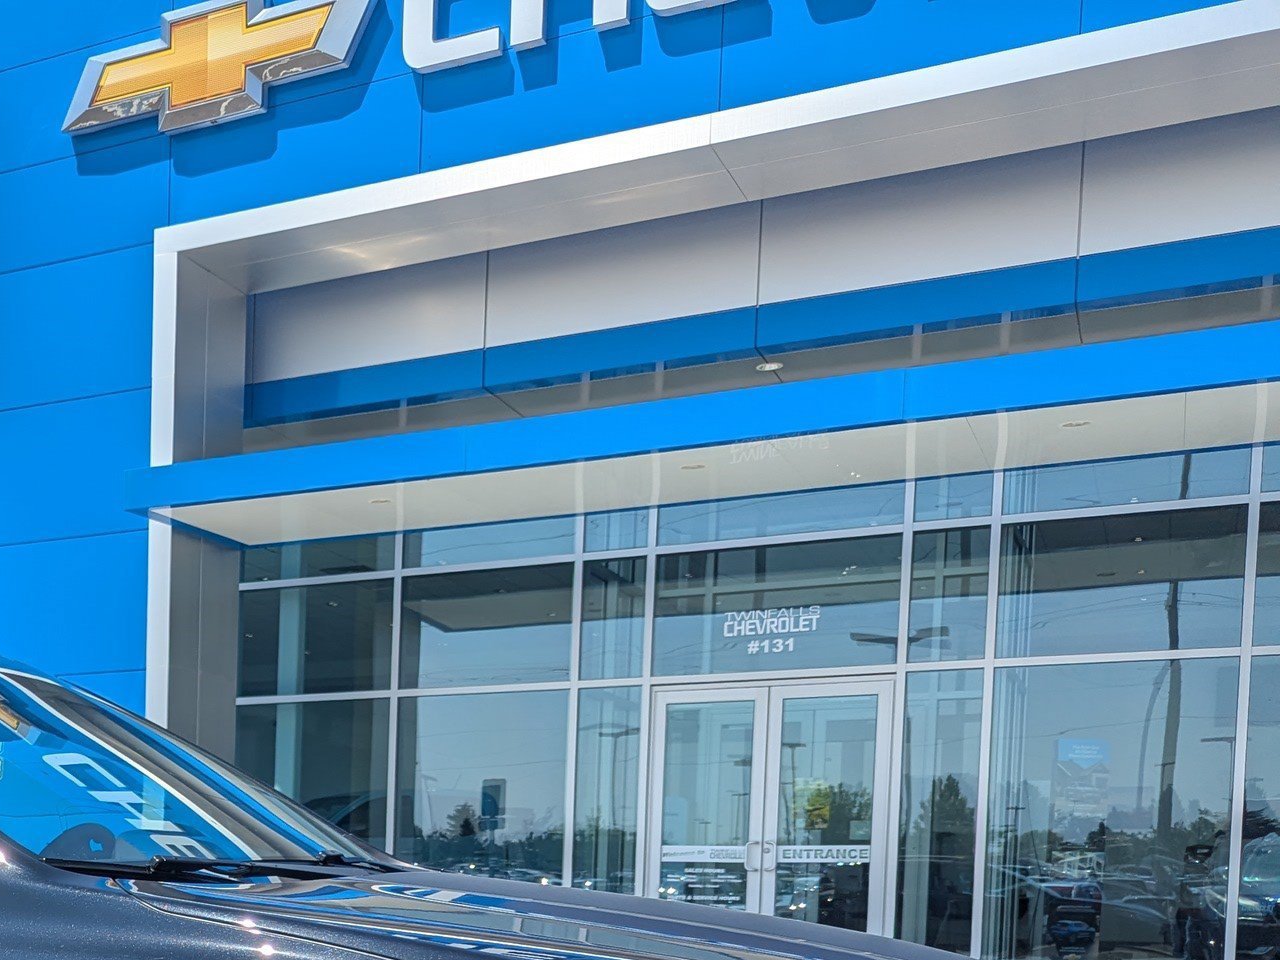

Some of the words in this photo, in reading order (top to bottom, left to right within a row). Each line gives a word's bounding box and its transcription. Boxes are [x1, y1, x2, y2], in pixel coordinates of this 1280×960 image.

[723, 614, 820, 637] CHEVROLET
[747, 637, 795, 654] #131
[781, 848, 869, 860] ENTRANCE
